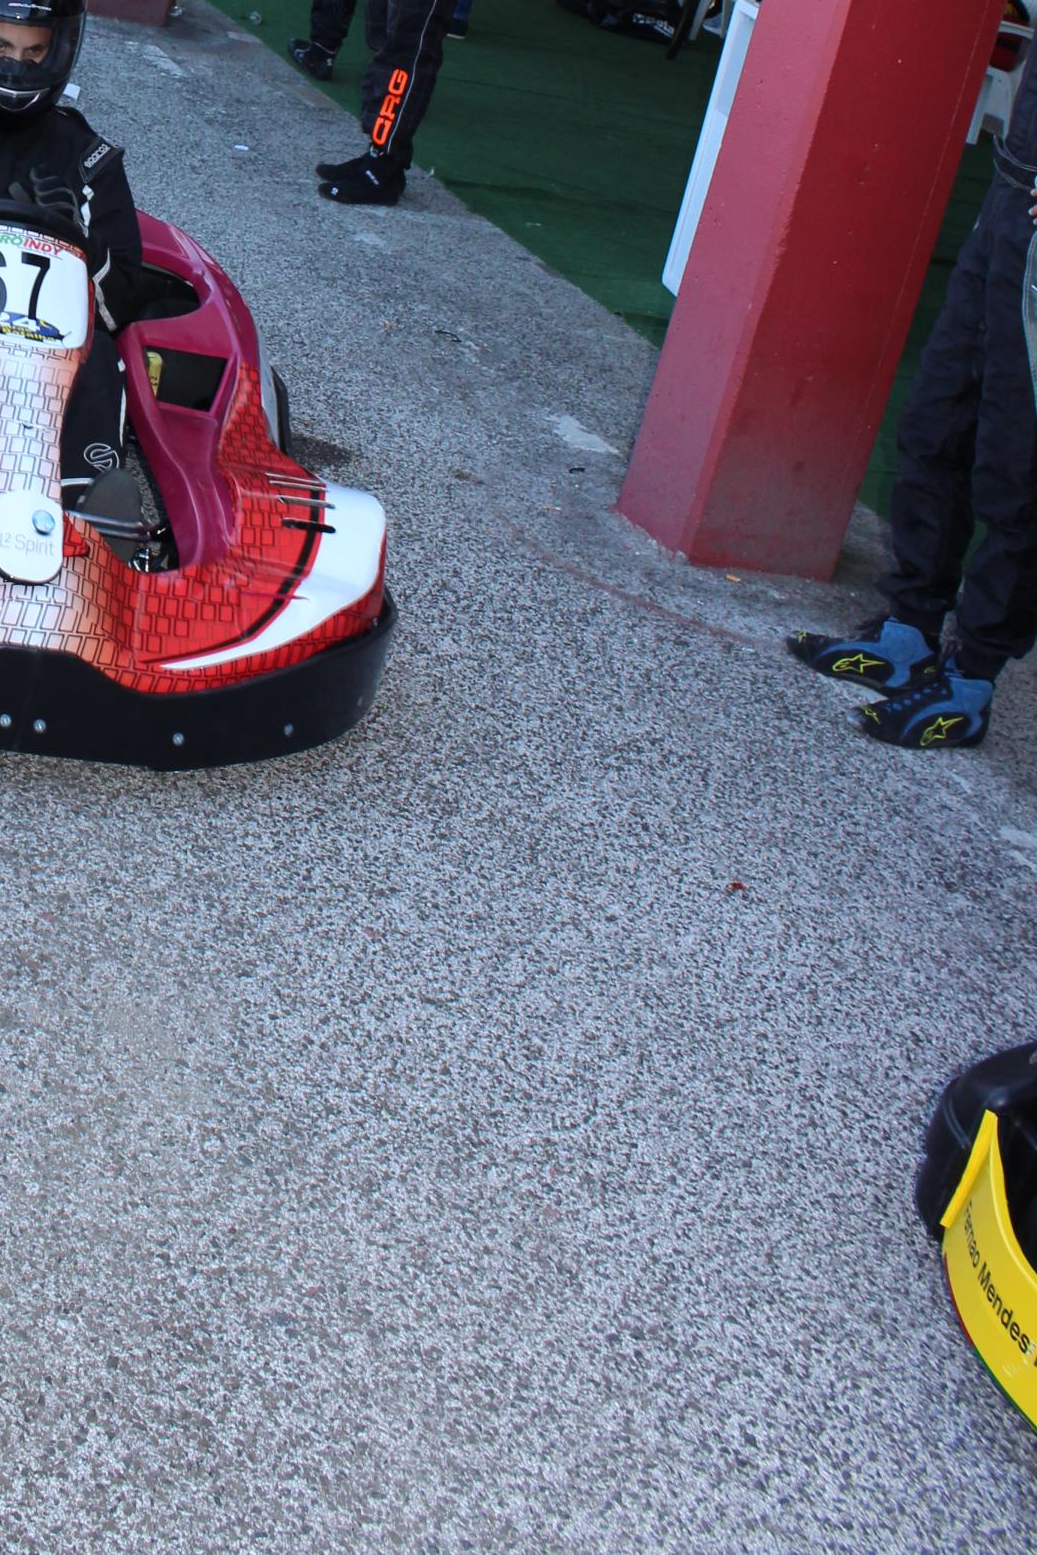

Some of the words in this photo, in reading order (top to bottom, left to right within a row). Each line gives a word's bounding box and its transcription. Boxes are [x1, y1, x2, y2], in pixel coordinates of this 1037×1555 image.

[372, 68, 409, 146] CRG
[15, 534, 55, 557] Spirit
[977, 1260, 1031, 1355] Mendes
